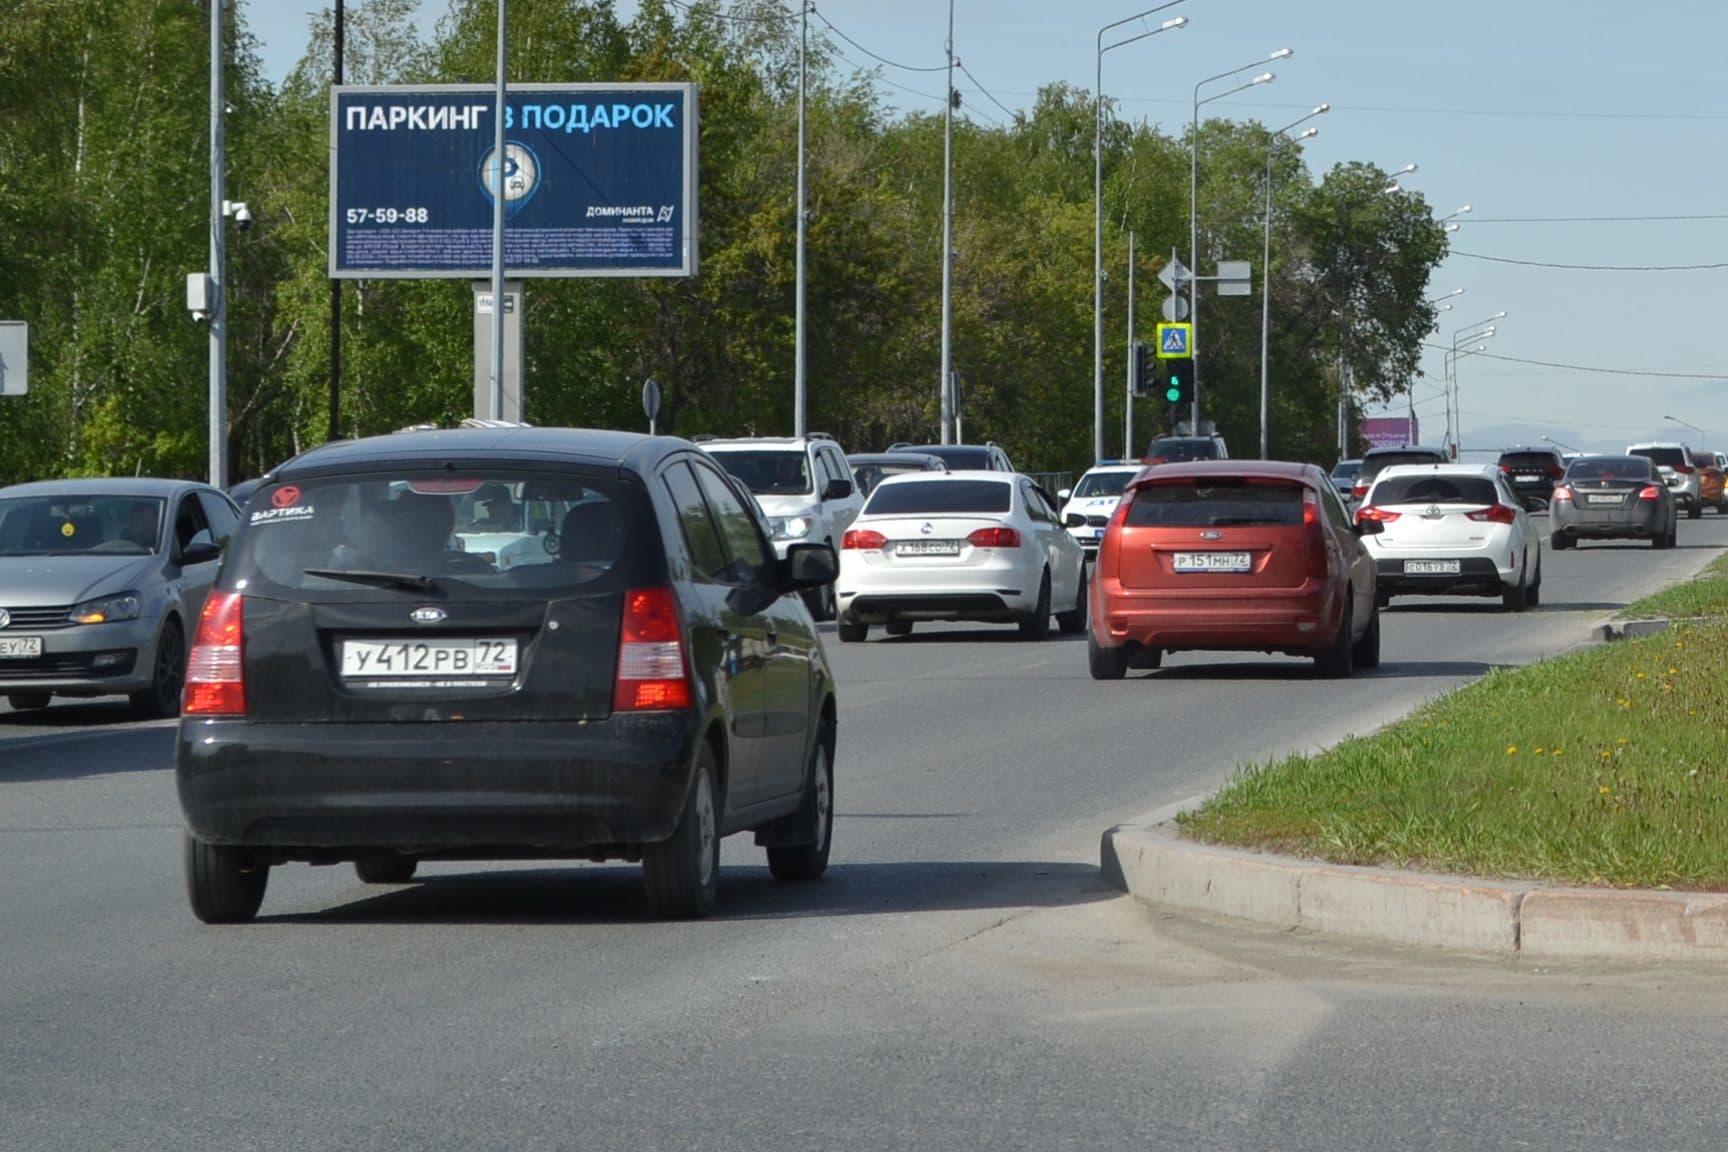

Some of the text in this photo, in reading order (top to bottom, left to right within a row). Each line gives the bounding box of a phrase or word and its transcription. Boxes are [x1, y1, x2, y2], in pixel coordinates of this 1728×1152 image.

[346, 105, 488, 131] ПАРКИНГ
[522, 104, 675, 134] ПОДАРОК
[346, 207, 429, 224] 57-59-88
[586, 206, 654, 218] ДОМИНАНТА
[356, 641, 505, 671] У412РВ 72
